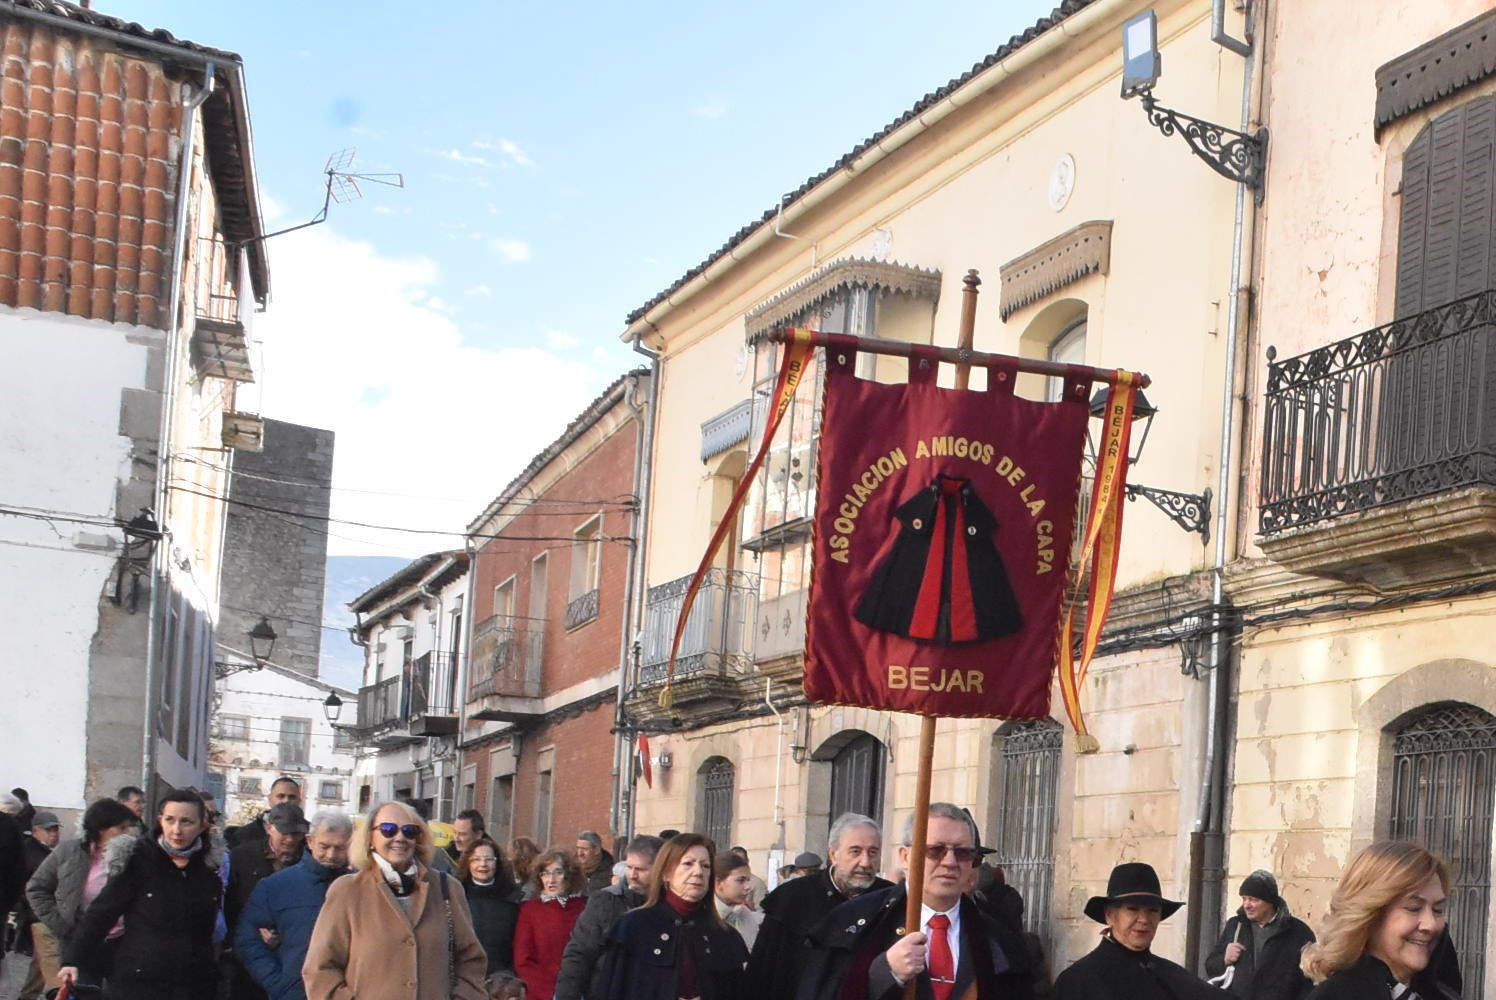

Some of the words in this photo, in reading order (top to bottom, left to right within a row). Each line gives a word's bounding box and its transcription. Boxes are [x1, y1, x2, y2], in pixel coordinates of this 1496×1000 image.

[1108, 405, 1124, 457] BEJAR
[829, 447, 908, 564] ASOCIACION
[915, 436, 994, 465] AMIGOS
[995, 456, 1026, 487] DE
[1020, 484, 1046, 517] LA
[1036, 520, 1055, 575] CAPA
[887, 665, 984, 692] BEJAR
